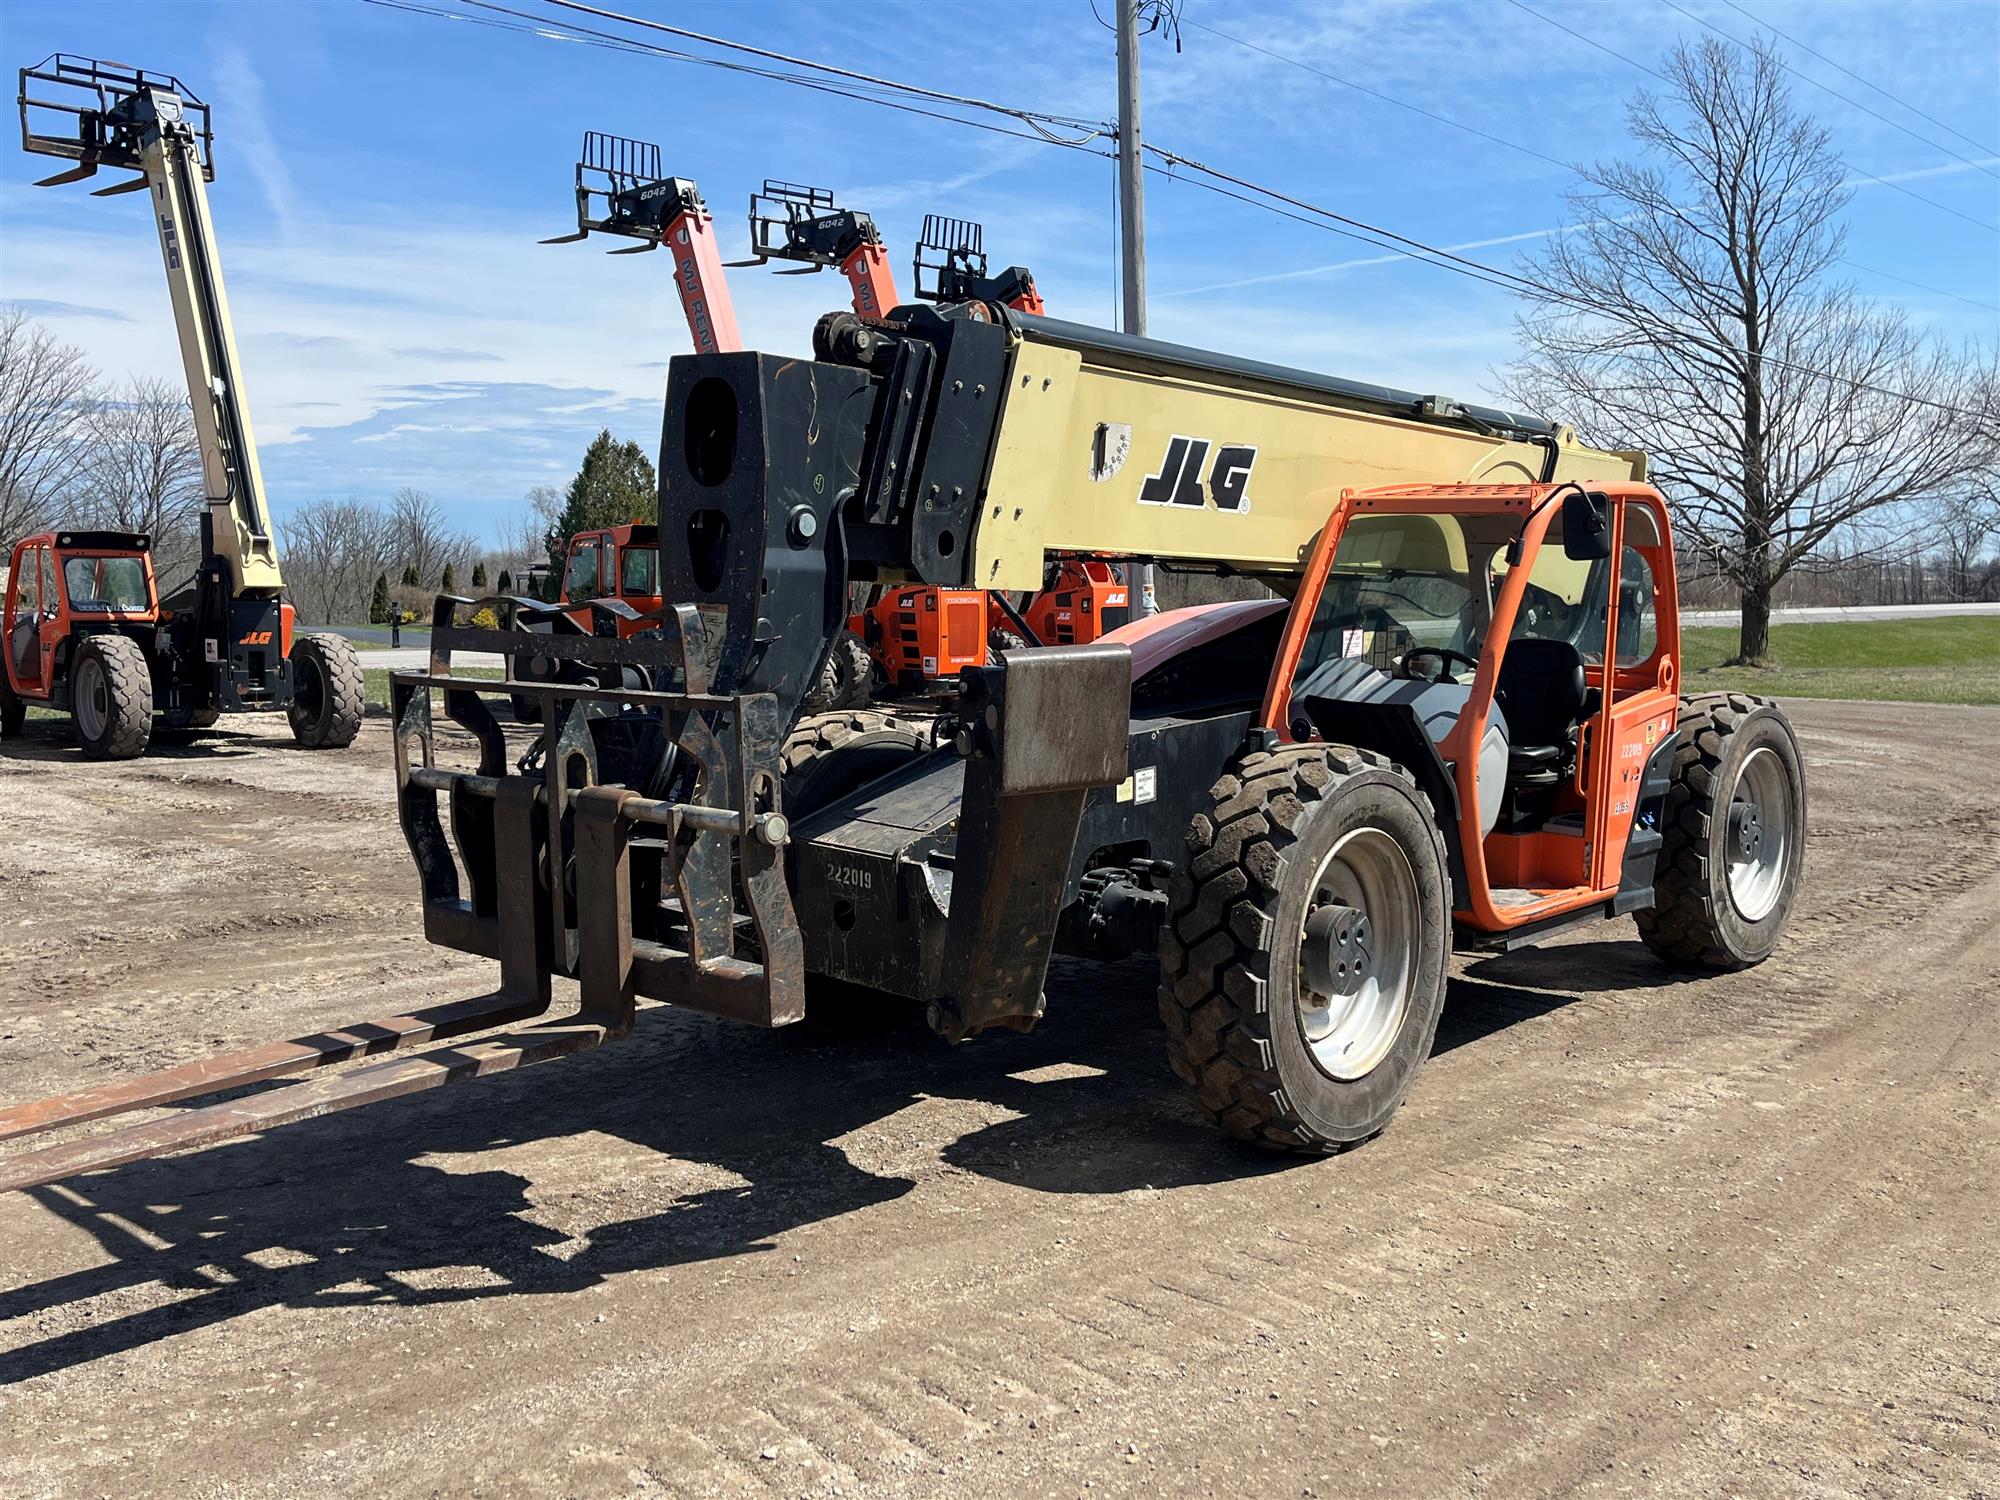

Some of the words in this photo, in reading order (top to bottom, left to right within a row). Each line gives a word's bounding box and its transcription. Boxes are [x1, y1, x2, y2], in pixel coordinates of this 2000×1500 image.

[641, 186, 666, 200] 6042
[818, 219, 844, 229] 6042
[161, 214, 181, 269] JLG
[682, 257, 699, 293] MJ
[859, 283, 874, 311] MJ
[1138, 435, 1256, 512] JLG
[901, 599, 914, 608] JLG
[1105, 594, 1126, 604] JLG
[1057, 612, 1072, 620] JLG
[239, 631, 272, 644] JLG
[827, 863, 871, 889] 222019
